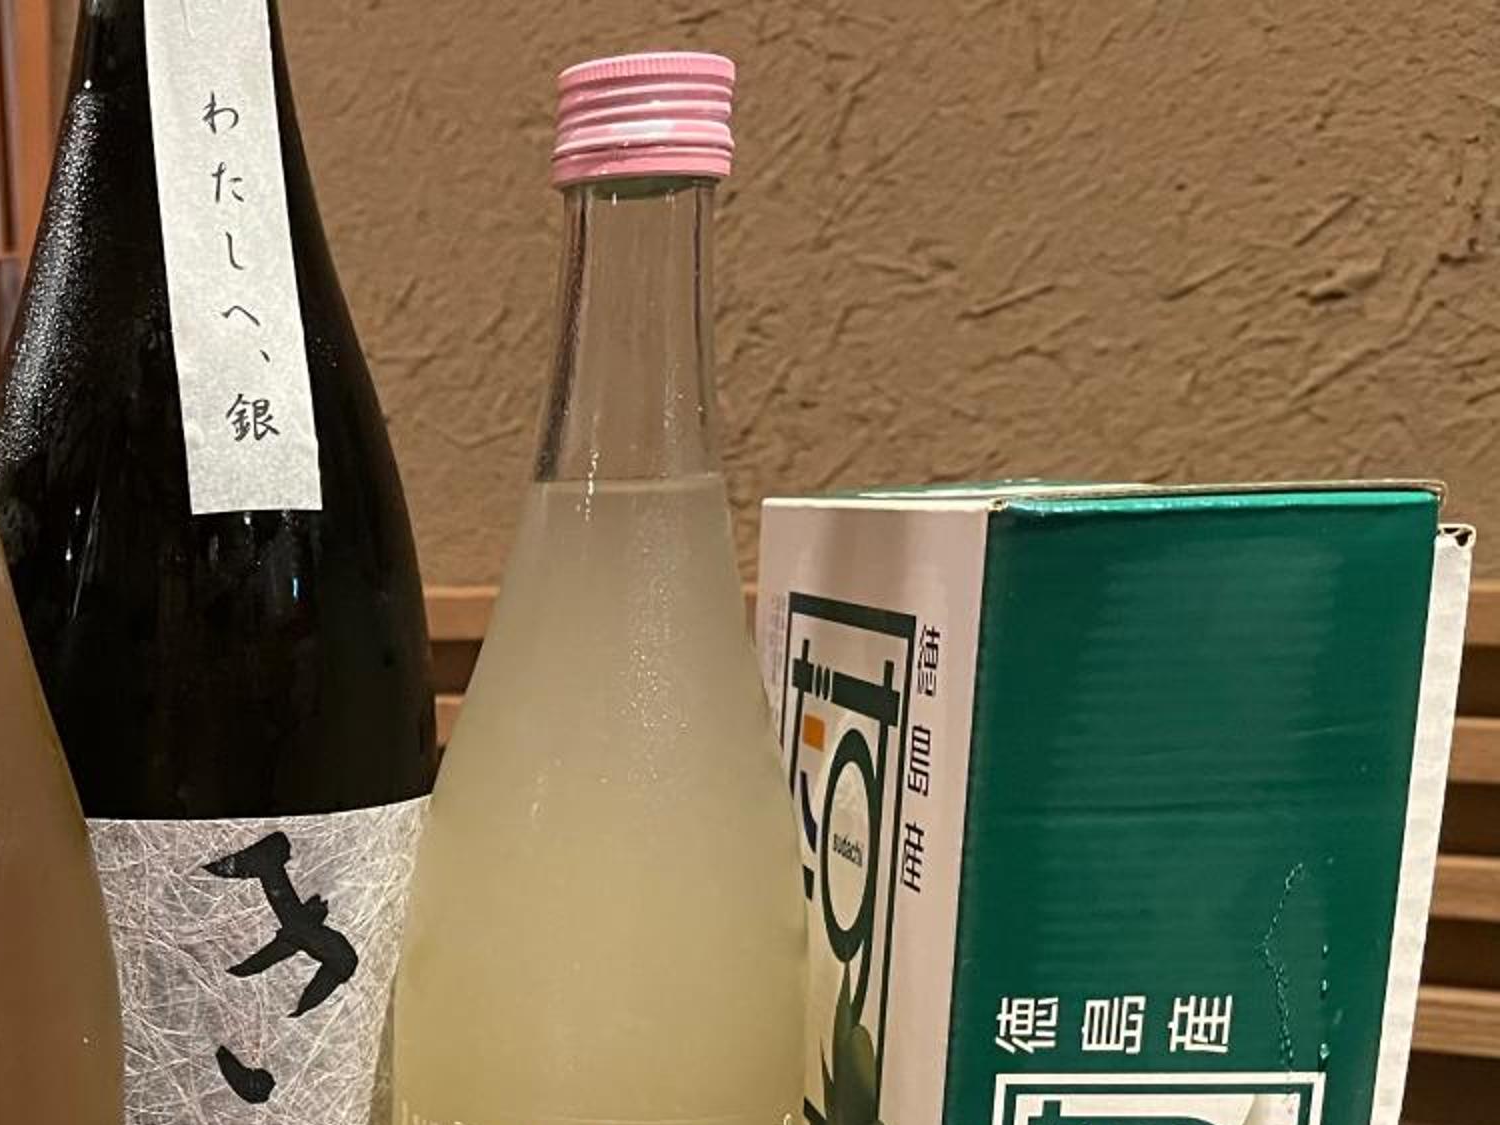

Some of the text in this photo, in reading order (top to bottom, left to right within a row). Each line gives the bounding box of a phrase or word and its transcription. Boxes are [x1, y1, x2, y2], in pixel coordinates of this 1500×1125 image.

[202, 91, 280, 441] わたしへ、銀
[996, 995, 1233, 1054] 徳島産
